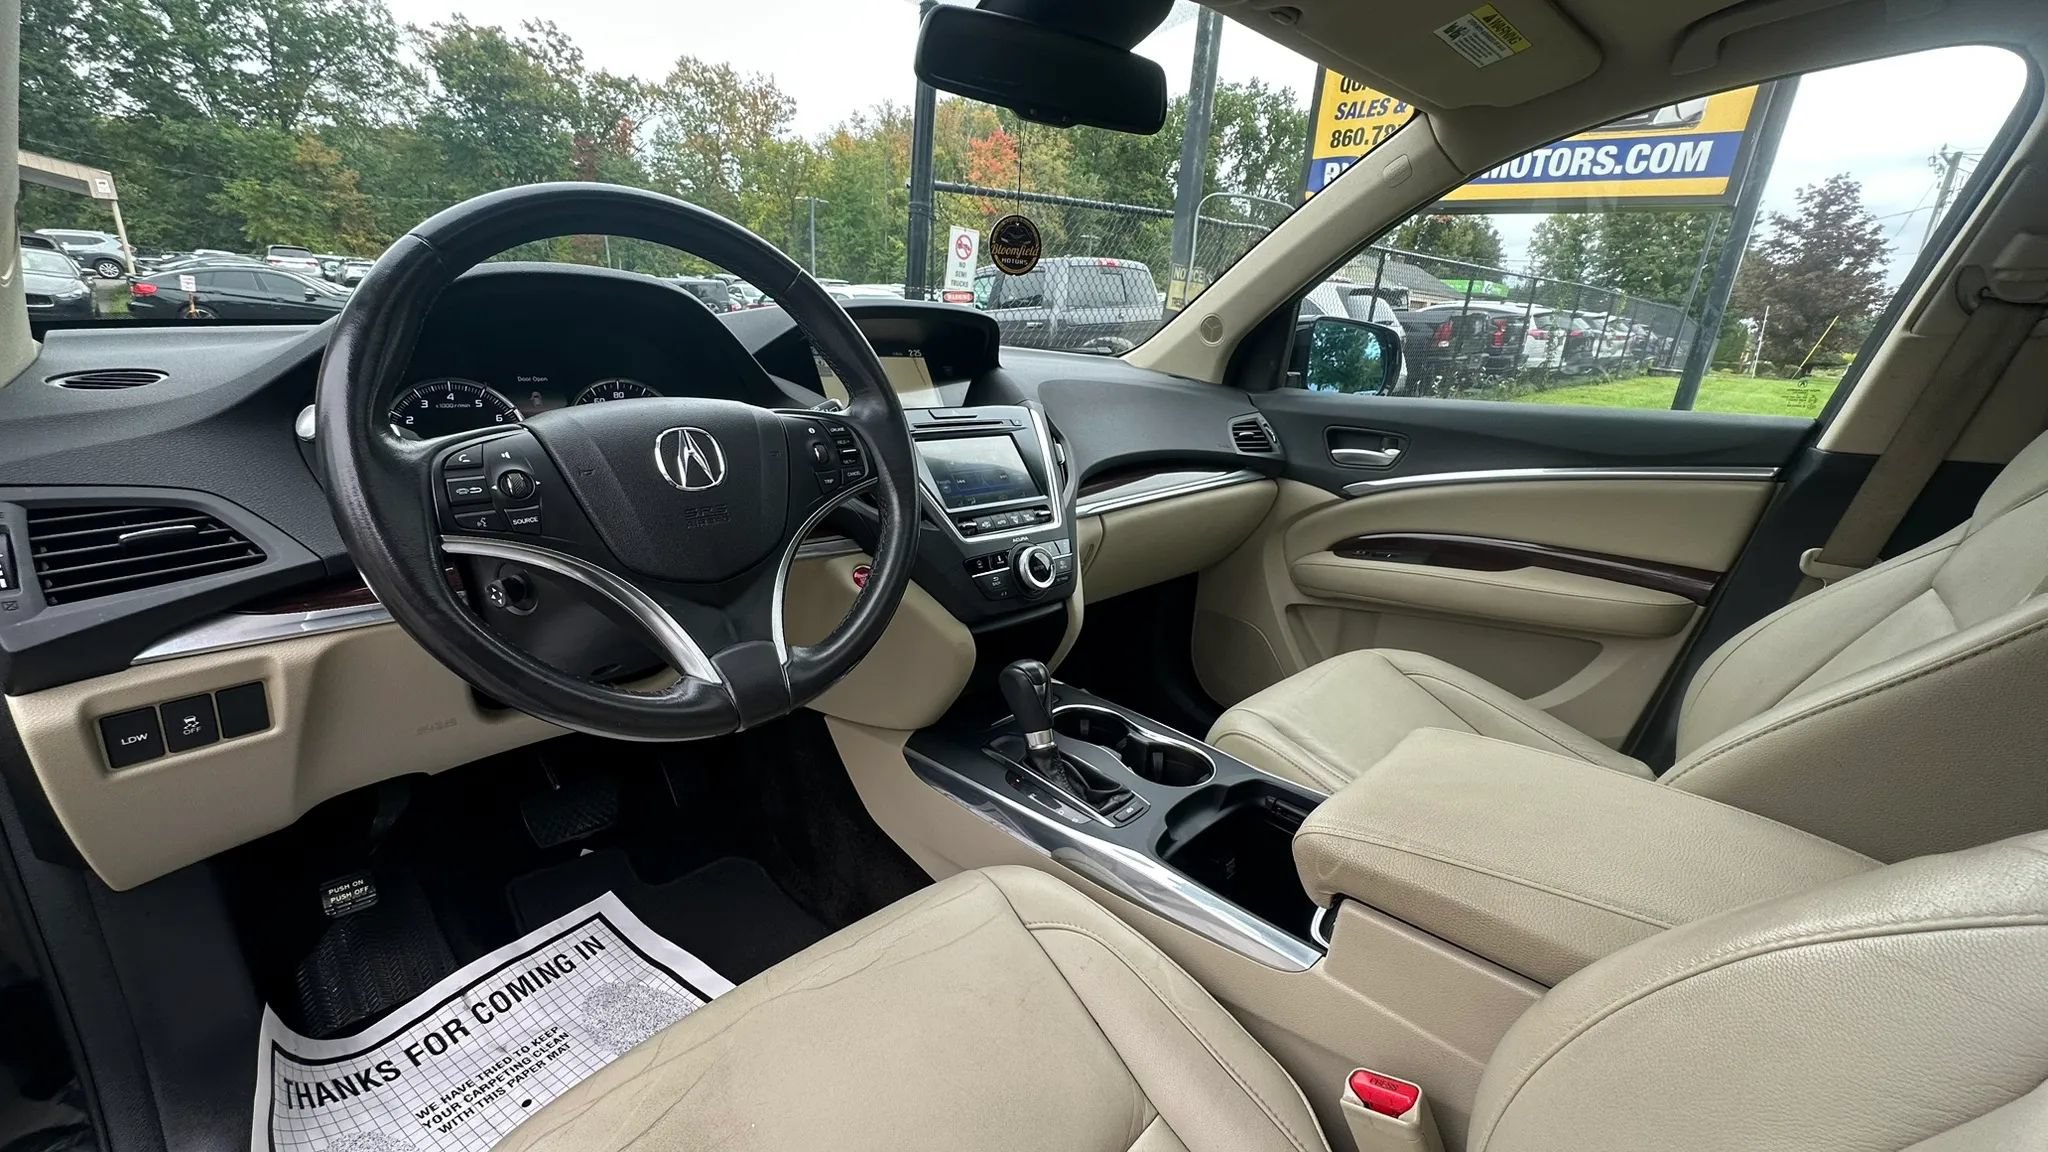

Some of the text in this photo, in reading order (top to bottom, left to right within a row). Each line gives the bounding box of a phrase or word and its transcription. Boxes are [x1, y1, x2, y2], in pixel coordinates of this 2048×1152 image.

[1334, 98, 1408, 121] SALES &
[991, 243, 1040, 258] Bloomfield
[1001, 257, 1028, 265] MOTORS
[446, 392, 455, 401] 4
[613, 391, 625, 399] 80
[420, 399, 429, 409] 3
[475, 399, 483, 408] 5
[406, 415, 414, 425] 2
[495, 413, 503, 423] 6
[512, 516, 539, 526] SOURCE
[1012, 535, 1029, 543] ACURA
[183, 726, 201, 736] OFF
[121, 732, 148, 746] LDW
[328, 879, 364, 895] PUSH ON
[330, 885, 369, 904] PUSH OFF
[284, 935, 606, 1110] THANKS FOR COMING IN
[415, 1026, 559, 1120] WE HAVE TRIED TO KEEP
[422, 1032, 570, 1129] YOUR CARPETING CLEAN
[1369, 1077, 1399, 1092] PRESS
[438, 1042, 571, 1134] WITH THIS PAPER MAT
